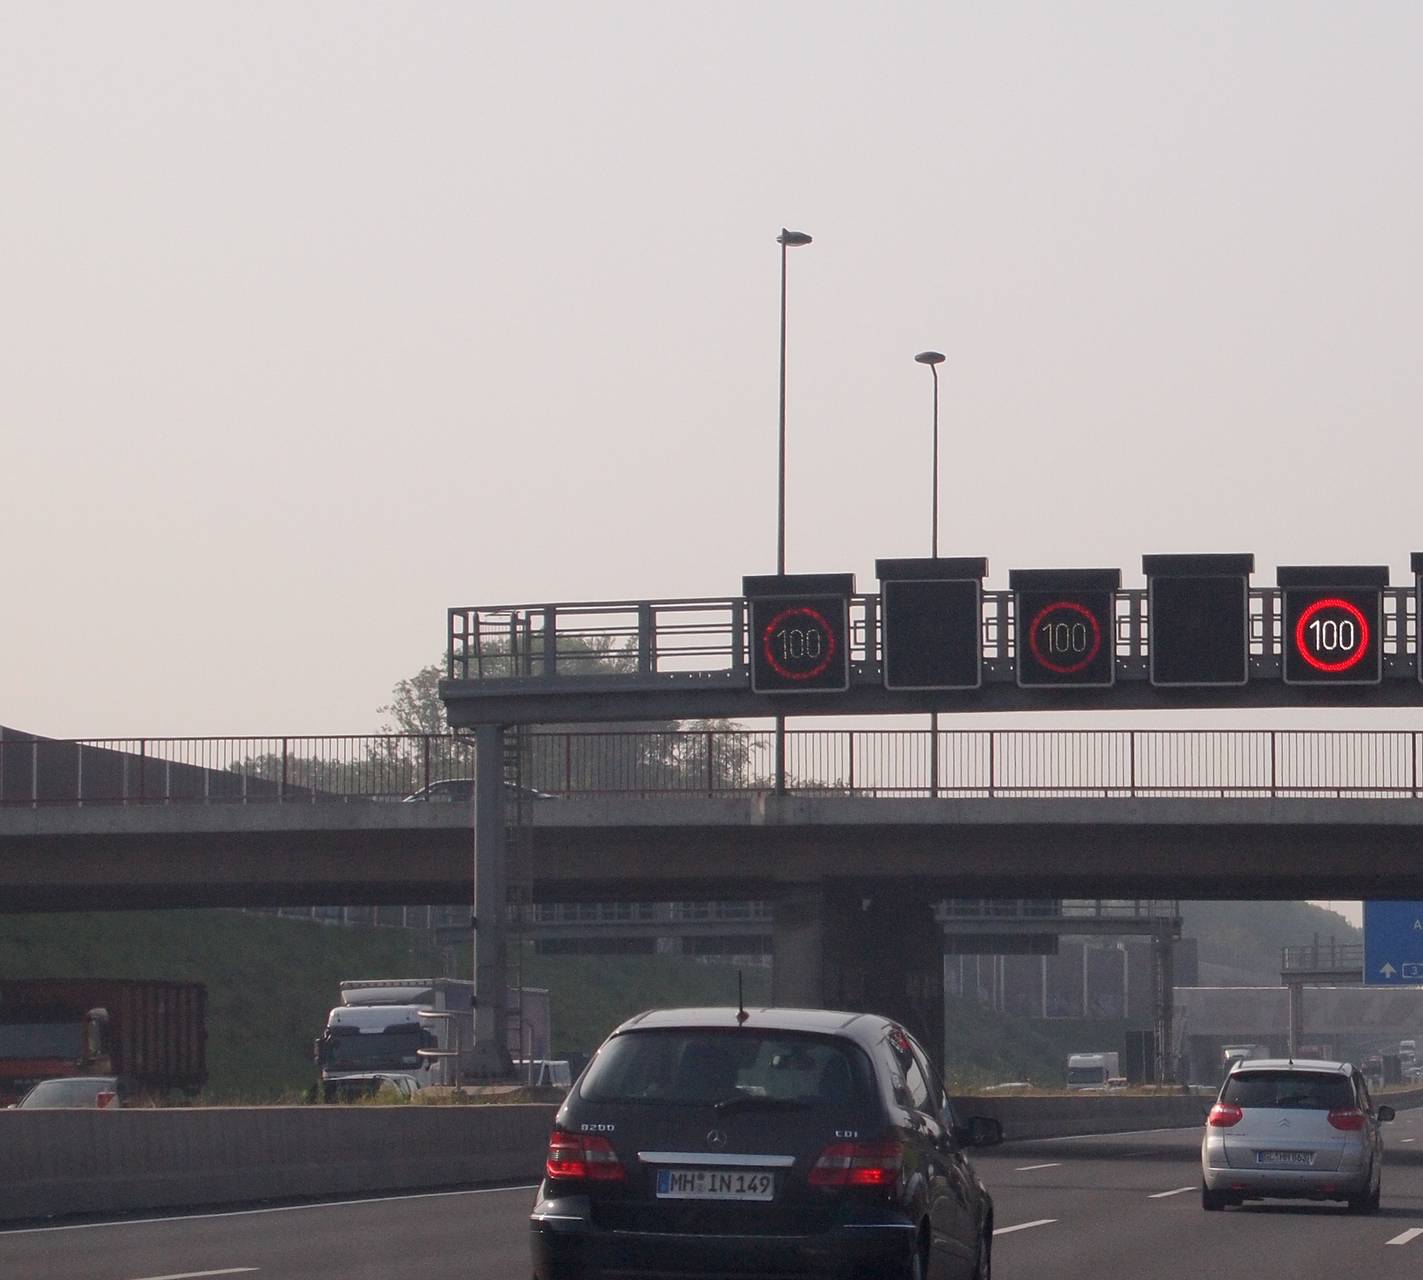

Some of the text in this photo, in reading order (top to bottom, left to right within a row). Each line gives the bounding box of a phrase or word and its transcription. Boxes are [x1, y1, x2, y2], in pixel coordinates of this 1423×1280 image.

[777, 627, 822, 660] 100
[1042, 622, 1087, 653] 100
[1310, 619, 1354, 651] 100
[671, 1173, 770, 1193] MH IN 149
